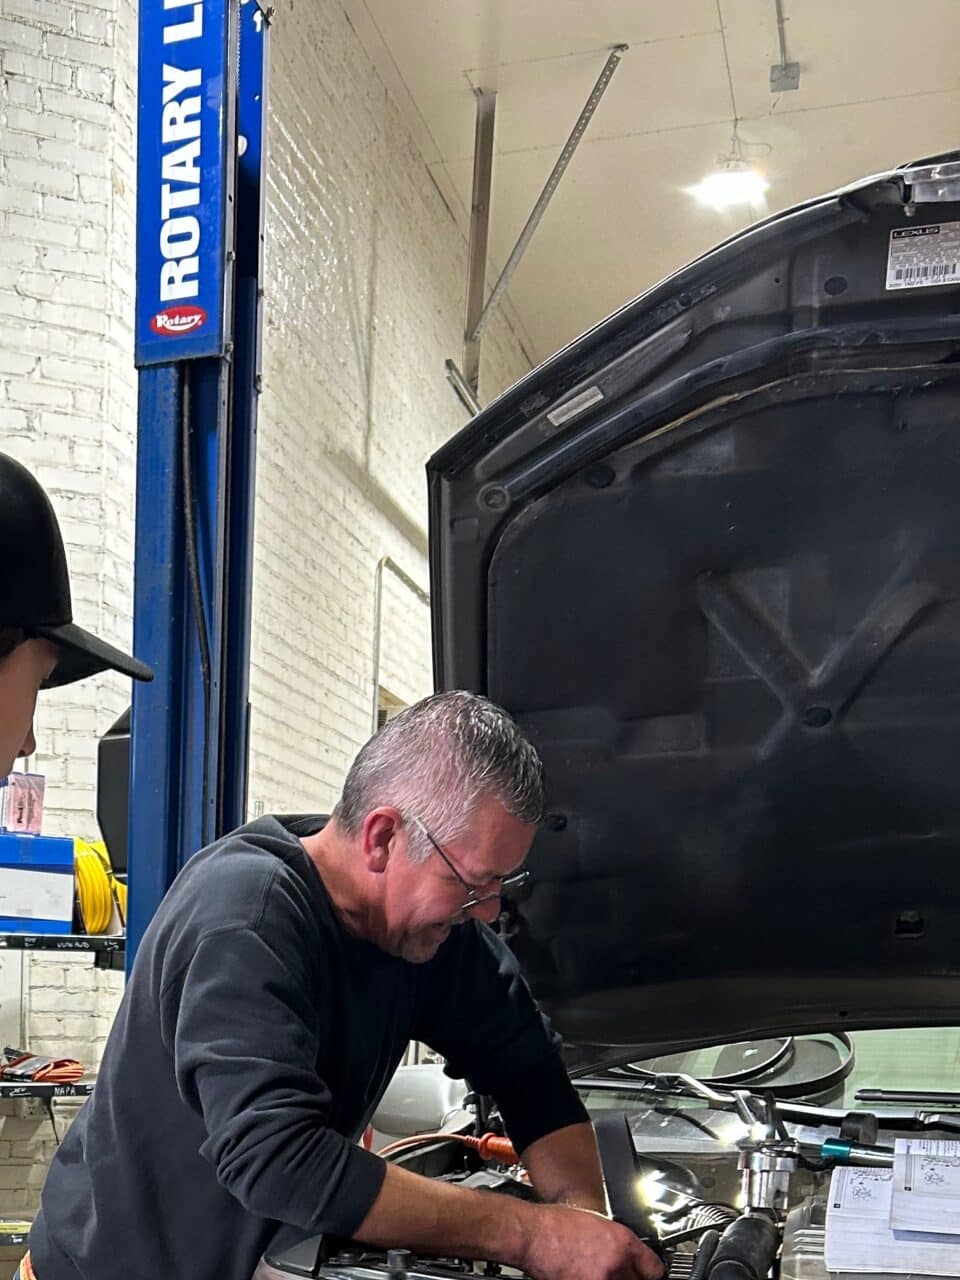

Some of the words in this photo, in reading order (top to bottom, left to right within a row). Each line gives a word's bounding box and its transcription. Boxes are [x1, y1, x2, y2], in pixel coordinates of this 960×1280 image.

[159, 64, 202, 302] ROTARY
[894, 227, 938, 237] LEXUS
[54, 1087, 76, 1096] NAPA
